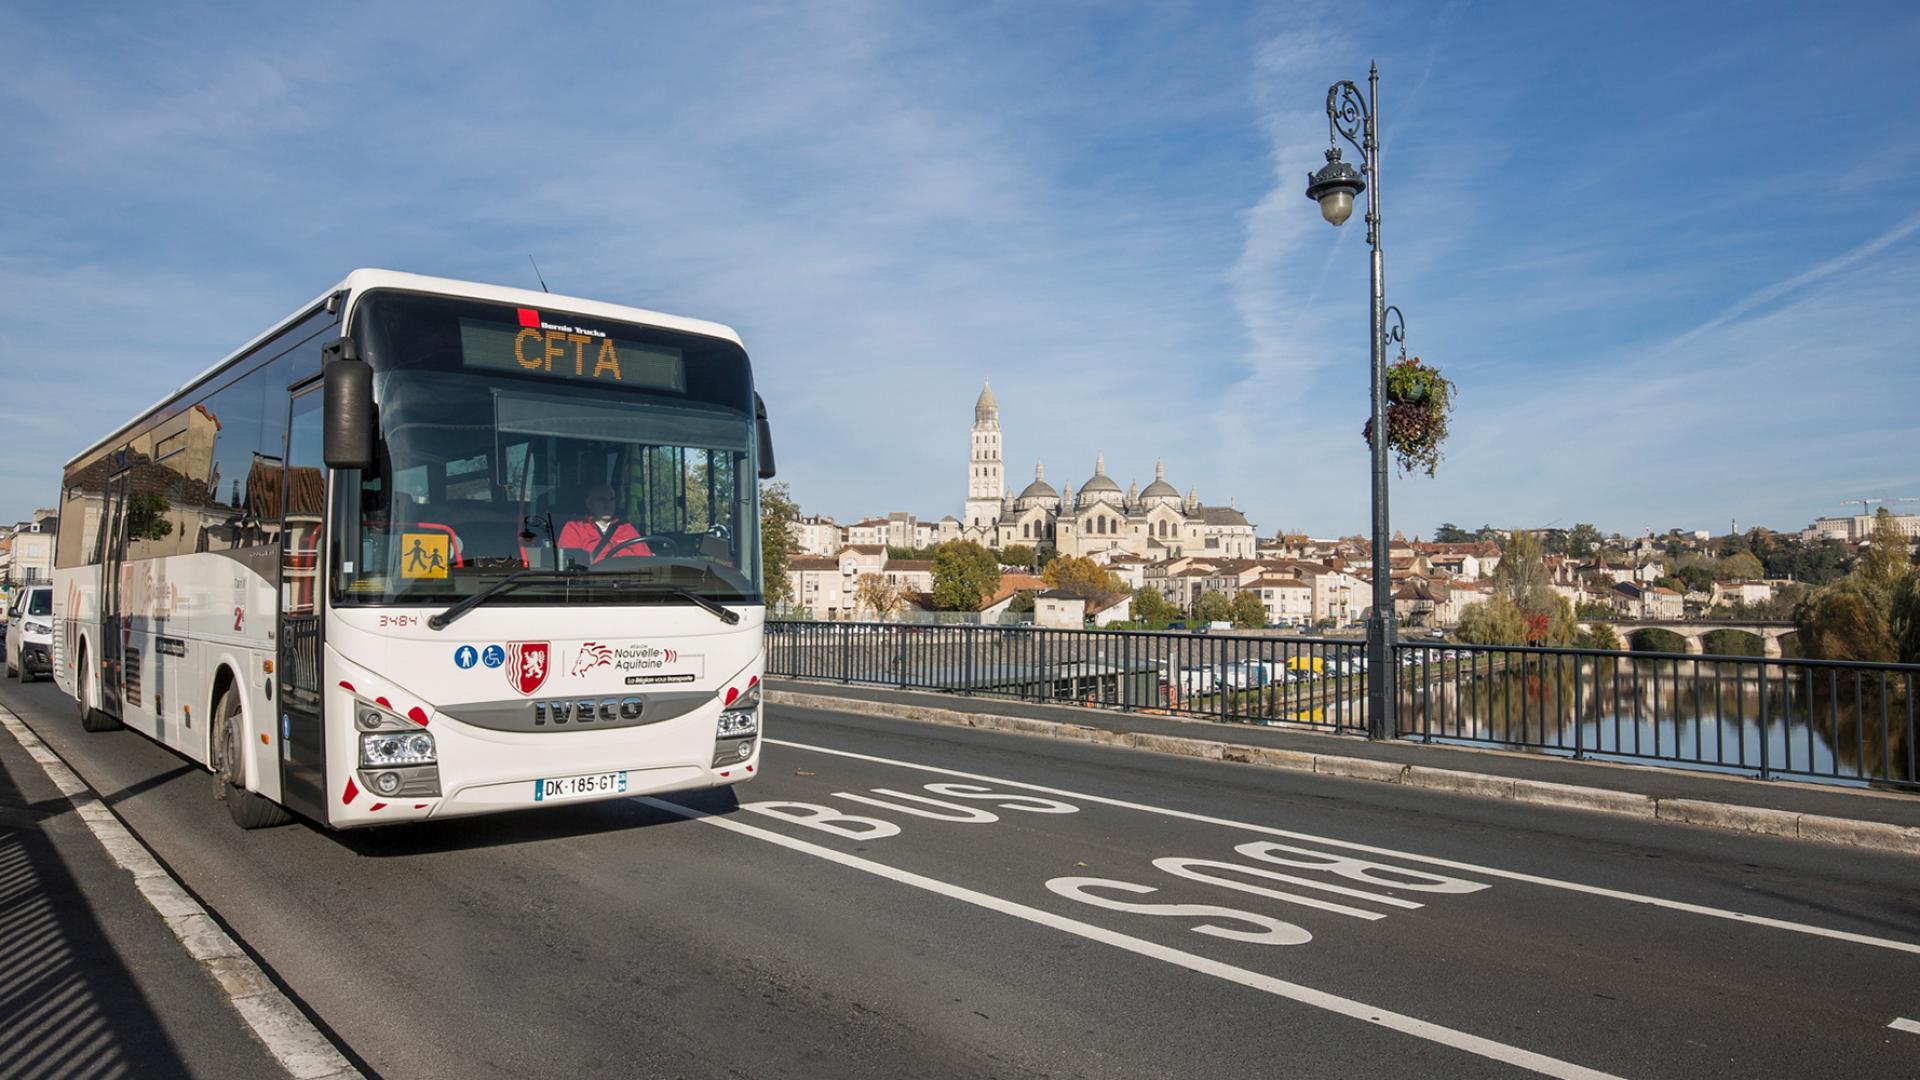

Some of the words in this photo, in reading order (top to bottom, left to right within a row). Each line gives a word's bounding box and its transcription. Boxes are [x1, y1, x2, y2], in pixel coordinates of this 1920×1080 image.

[574, 326, 606, 338] Trucks
[515, 327, 622, 380] CFTA
[379, 615, 418, 627] 3484
[614, 658, 663, 672] Aquitaine
[535, 697, 644, 725] IVECO
[738, 782, 1080, 841] BUS
[1045, 840, 1493, 946] BUS
